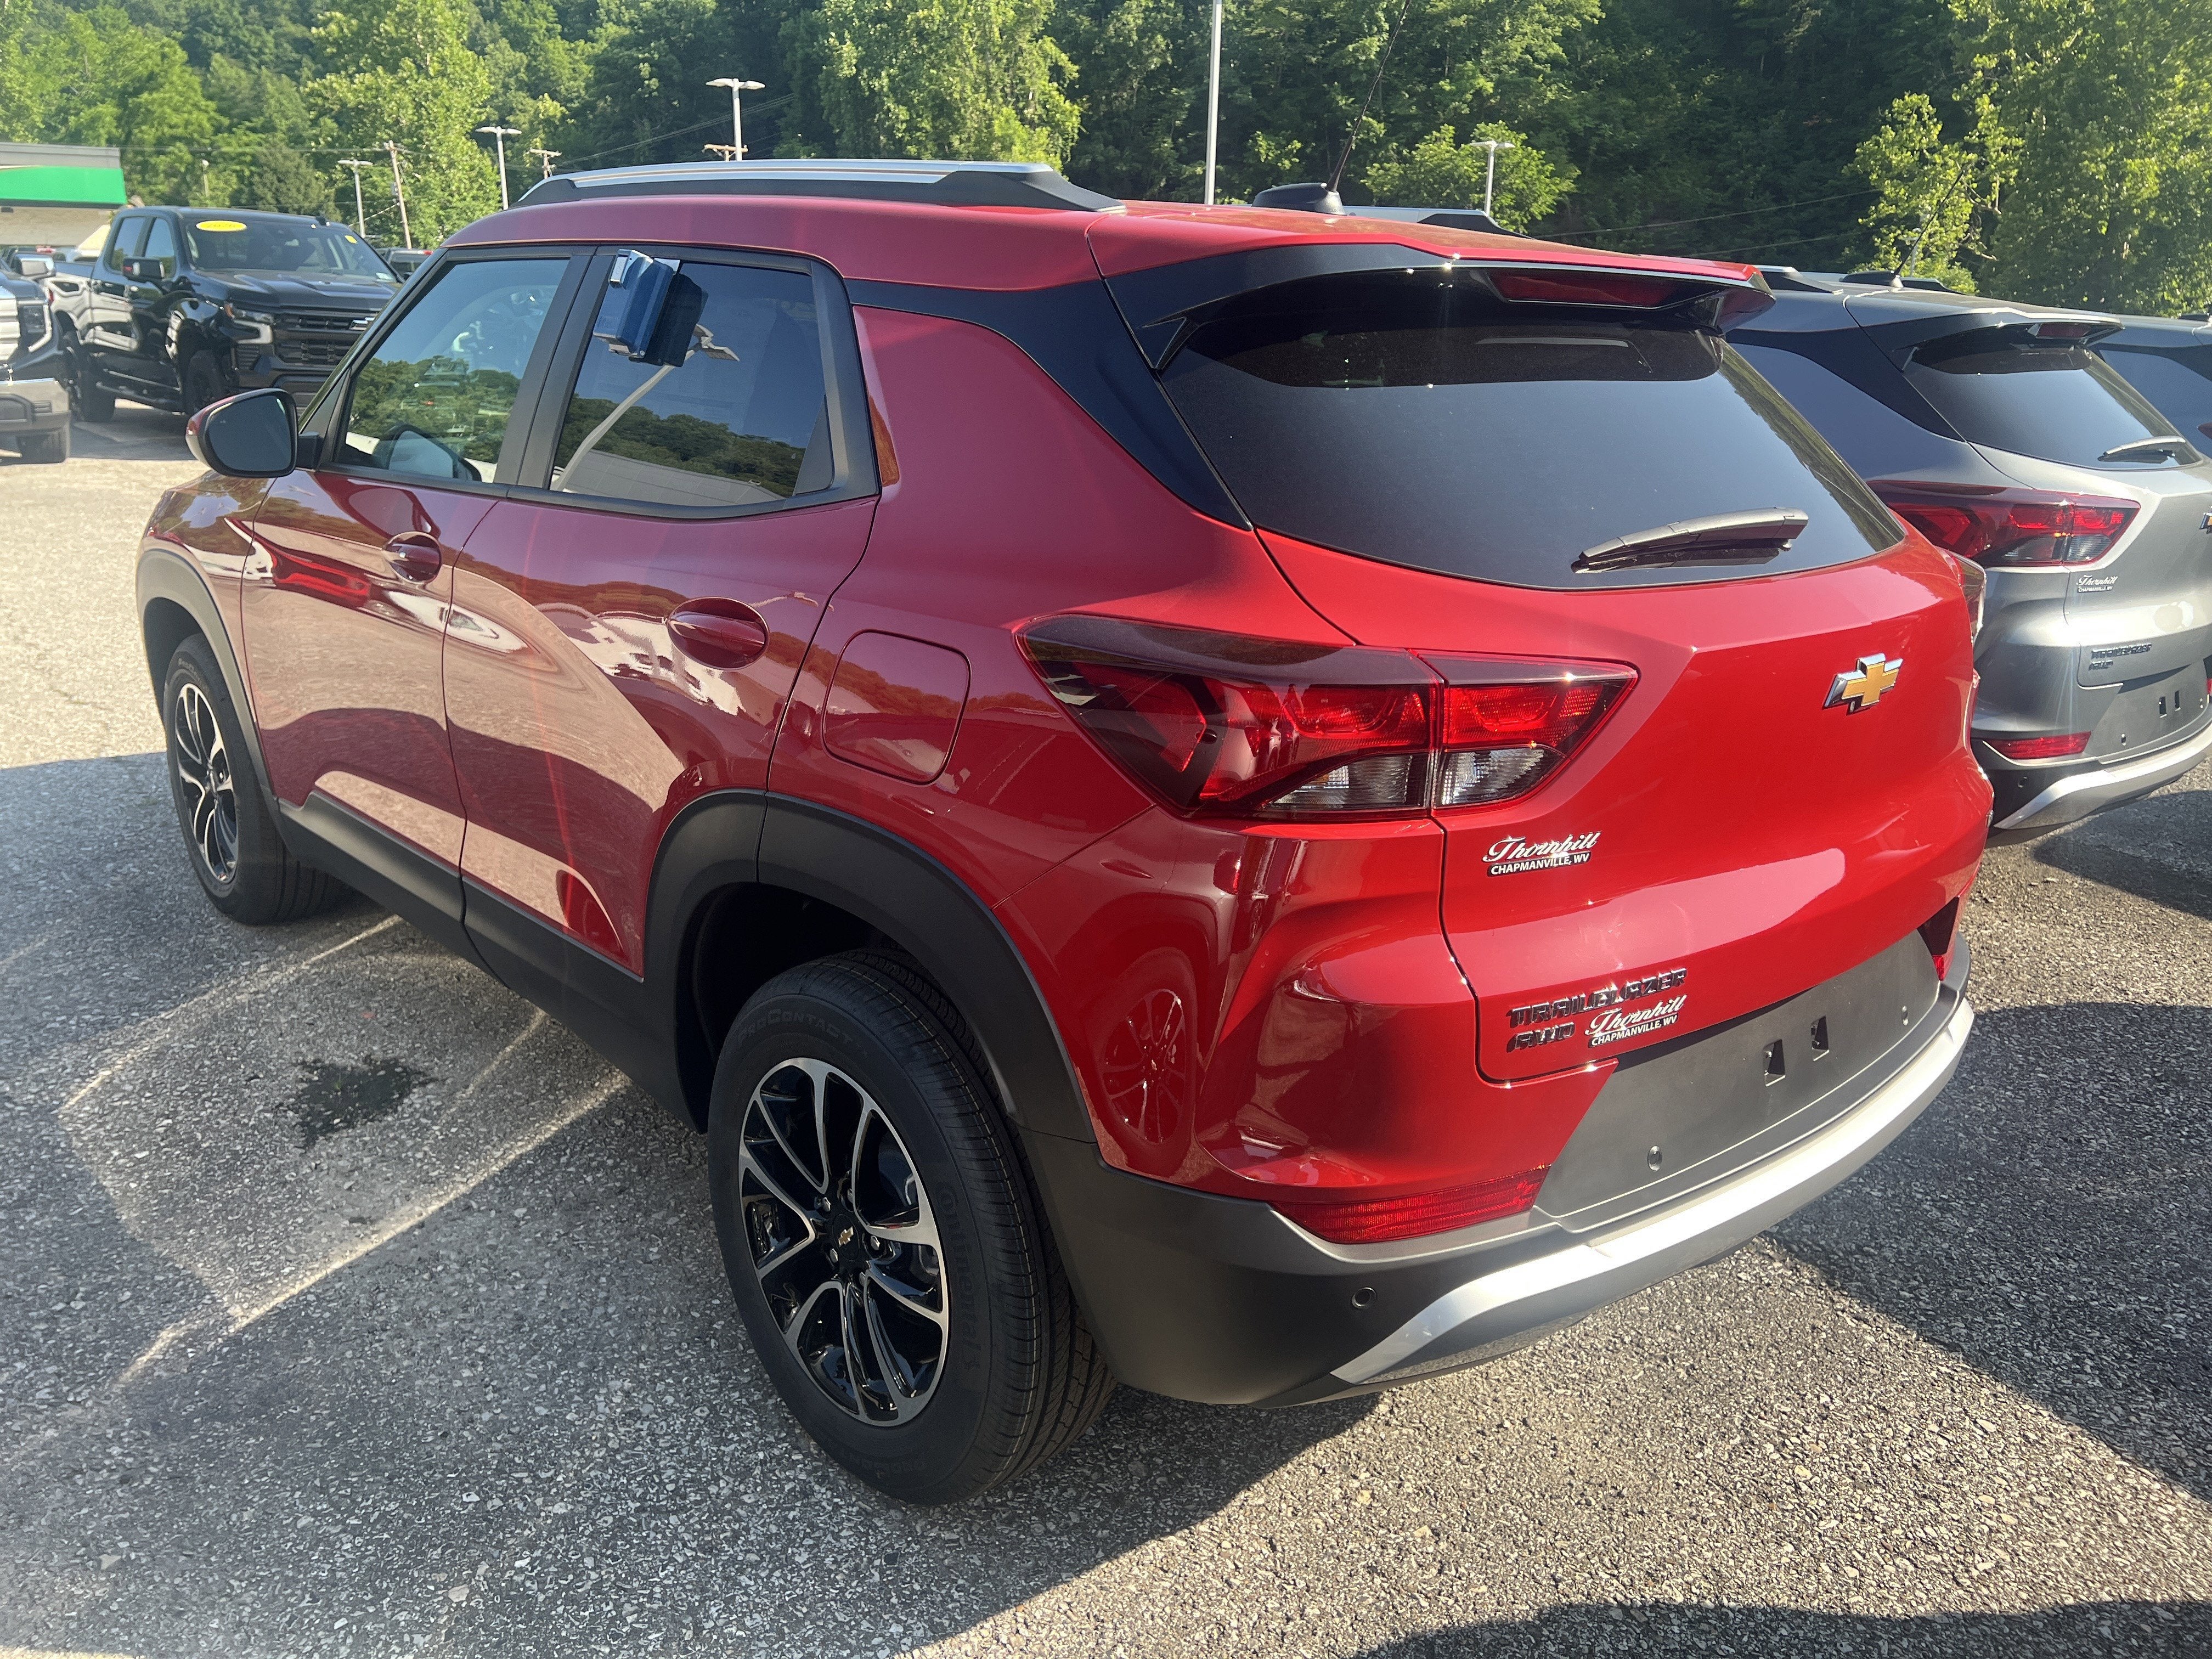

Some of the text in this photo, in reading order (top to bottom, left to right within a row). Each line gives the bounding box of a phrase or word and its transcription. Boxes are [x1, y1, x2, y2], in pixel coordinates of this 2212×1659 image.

[1481, 831, 1602, 862] Thornhill
[1491, 853, 1590, 875] CHAPMANVILLE, WV
[1505, 968, 1687, 1029] TRAILBLAZER
[1584, 995, 1688, 1036] Thornhill
[1592, 1015, 1678, 1046] CHAPMANVILLE, WV
[1507, 1022, 1576, 1053] AWD
